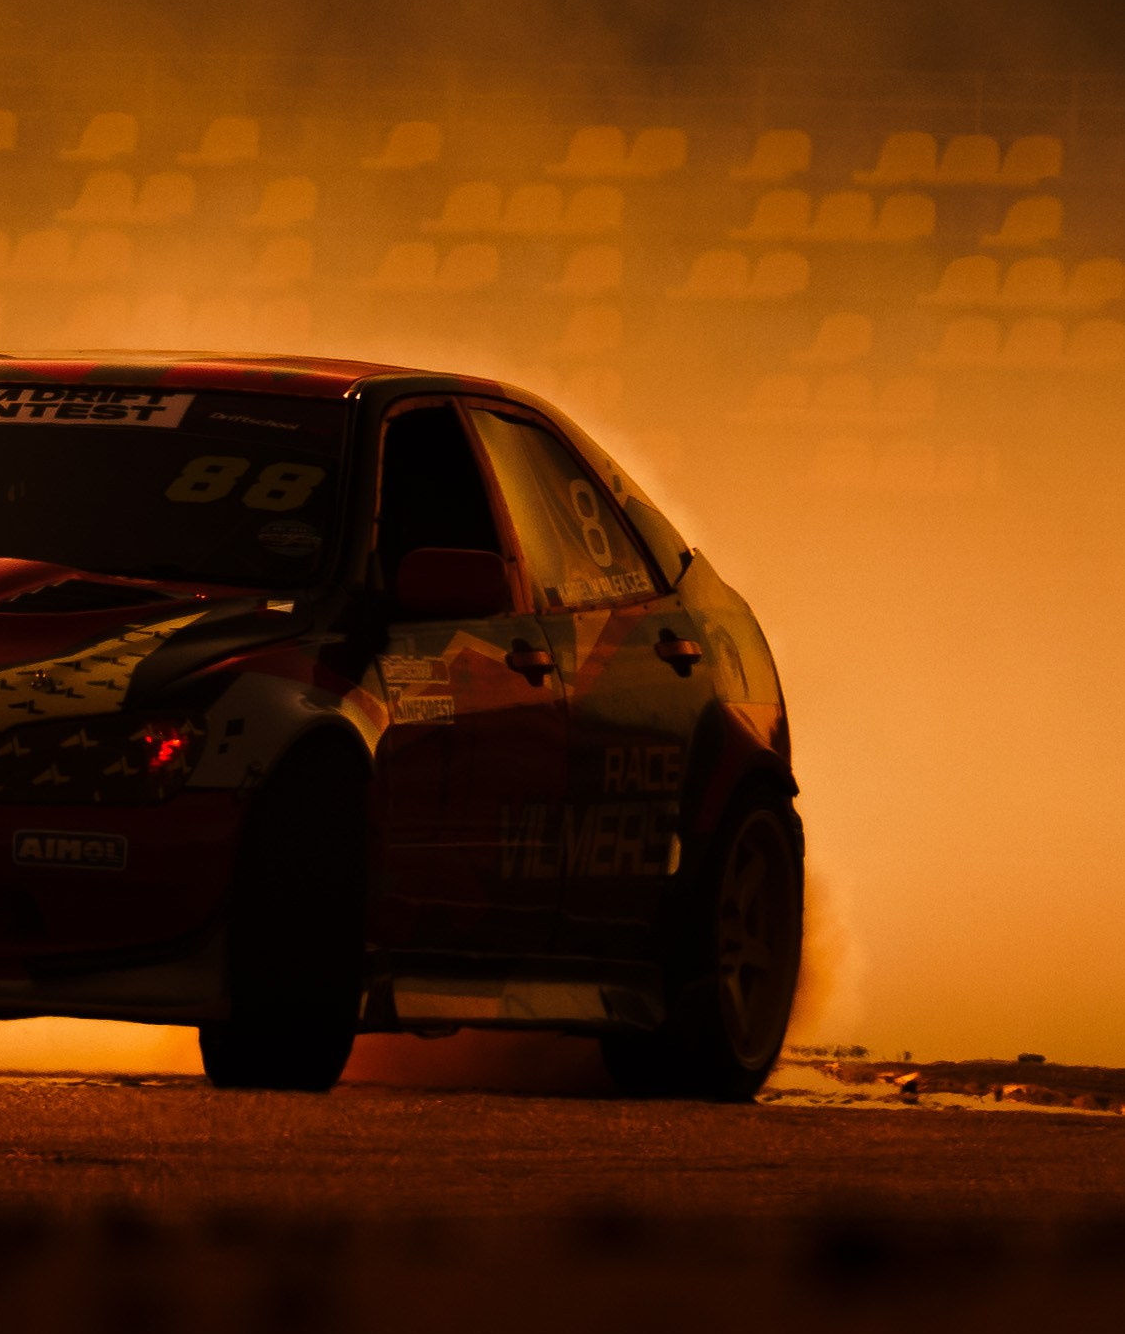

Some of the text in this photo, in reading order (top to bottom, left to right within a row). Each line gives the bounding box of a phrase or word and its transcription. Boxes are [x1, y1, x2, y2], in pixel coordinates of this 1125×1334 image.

[24, 390, 170, 406] DRIFT
[165, 455, 328, 512] 88
[603, 745, 682, 794] RACE
[500, 801, 681, 881] VILMERS
